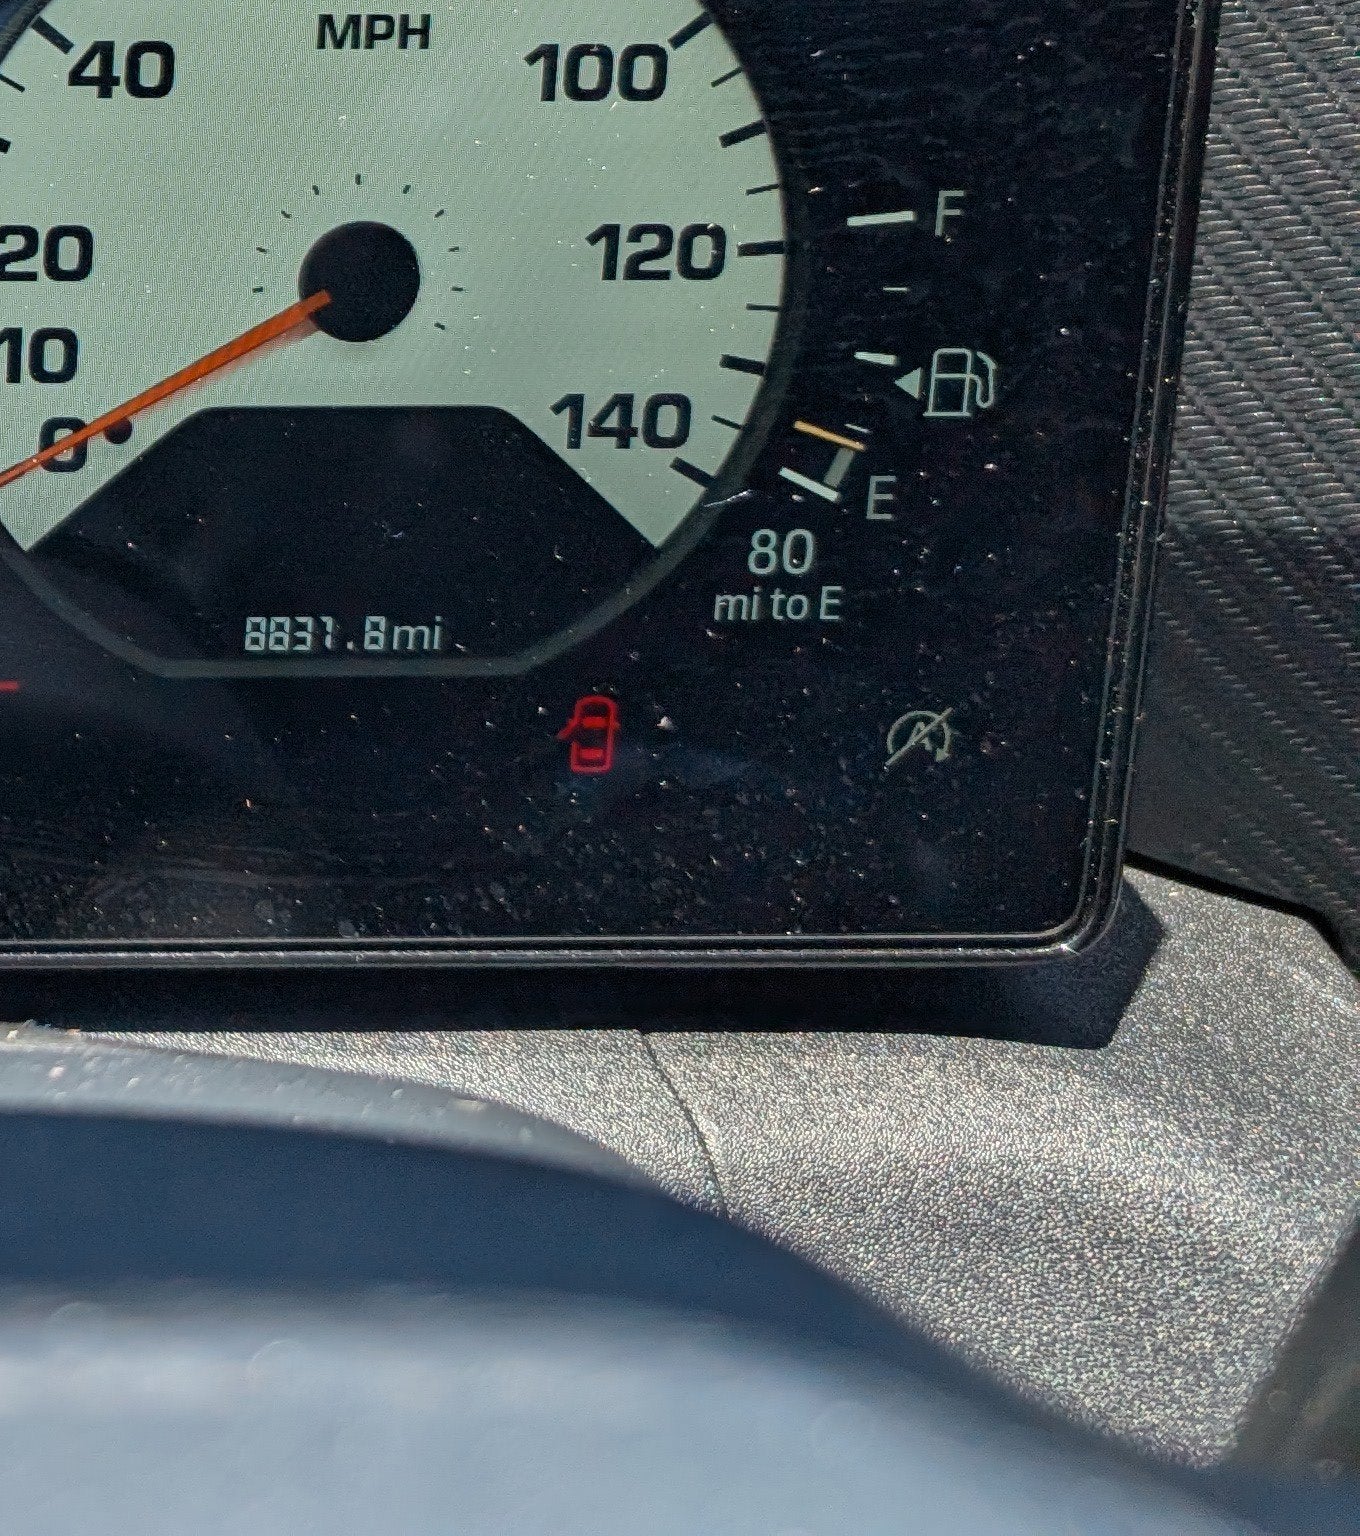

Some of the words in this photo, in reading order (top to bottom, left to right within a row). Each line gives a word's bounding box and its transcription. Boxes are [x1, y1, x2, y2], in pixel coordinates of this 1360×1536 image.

[316, 13, 432, 50] MPH
[68, 39, 176, 99] 40
[523, 43, 669, 103] 100
[934, 189, 965, 237] F
[584, 223, 727, 283] 120
[548, 392, 692, 450] 140
[865, 474, 898, 521] E
[747, 528, 815, 575] 80
[713, 586, 762, 621] mi
[769, 587, 809, 621] to
[819, 585, 843, 621] E
